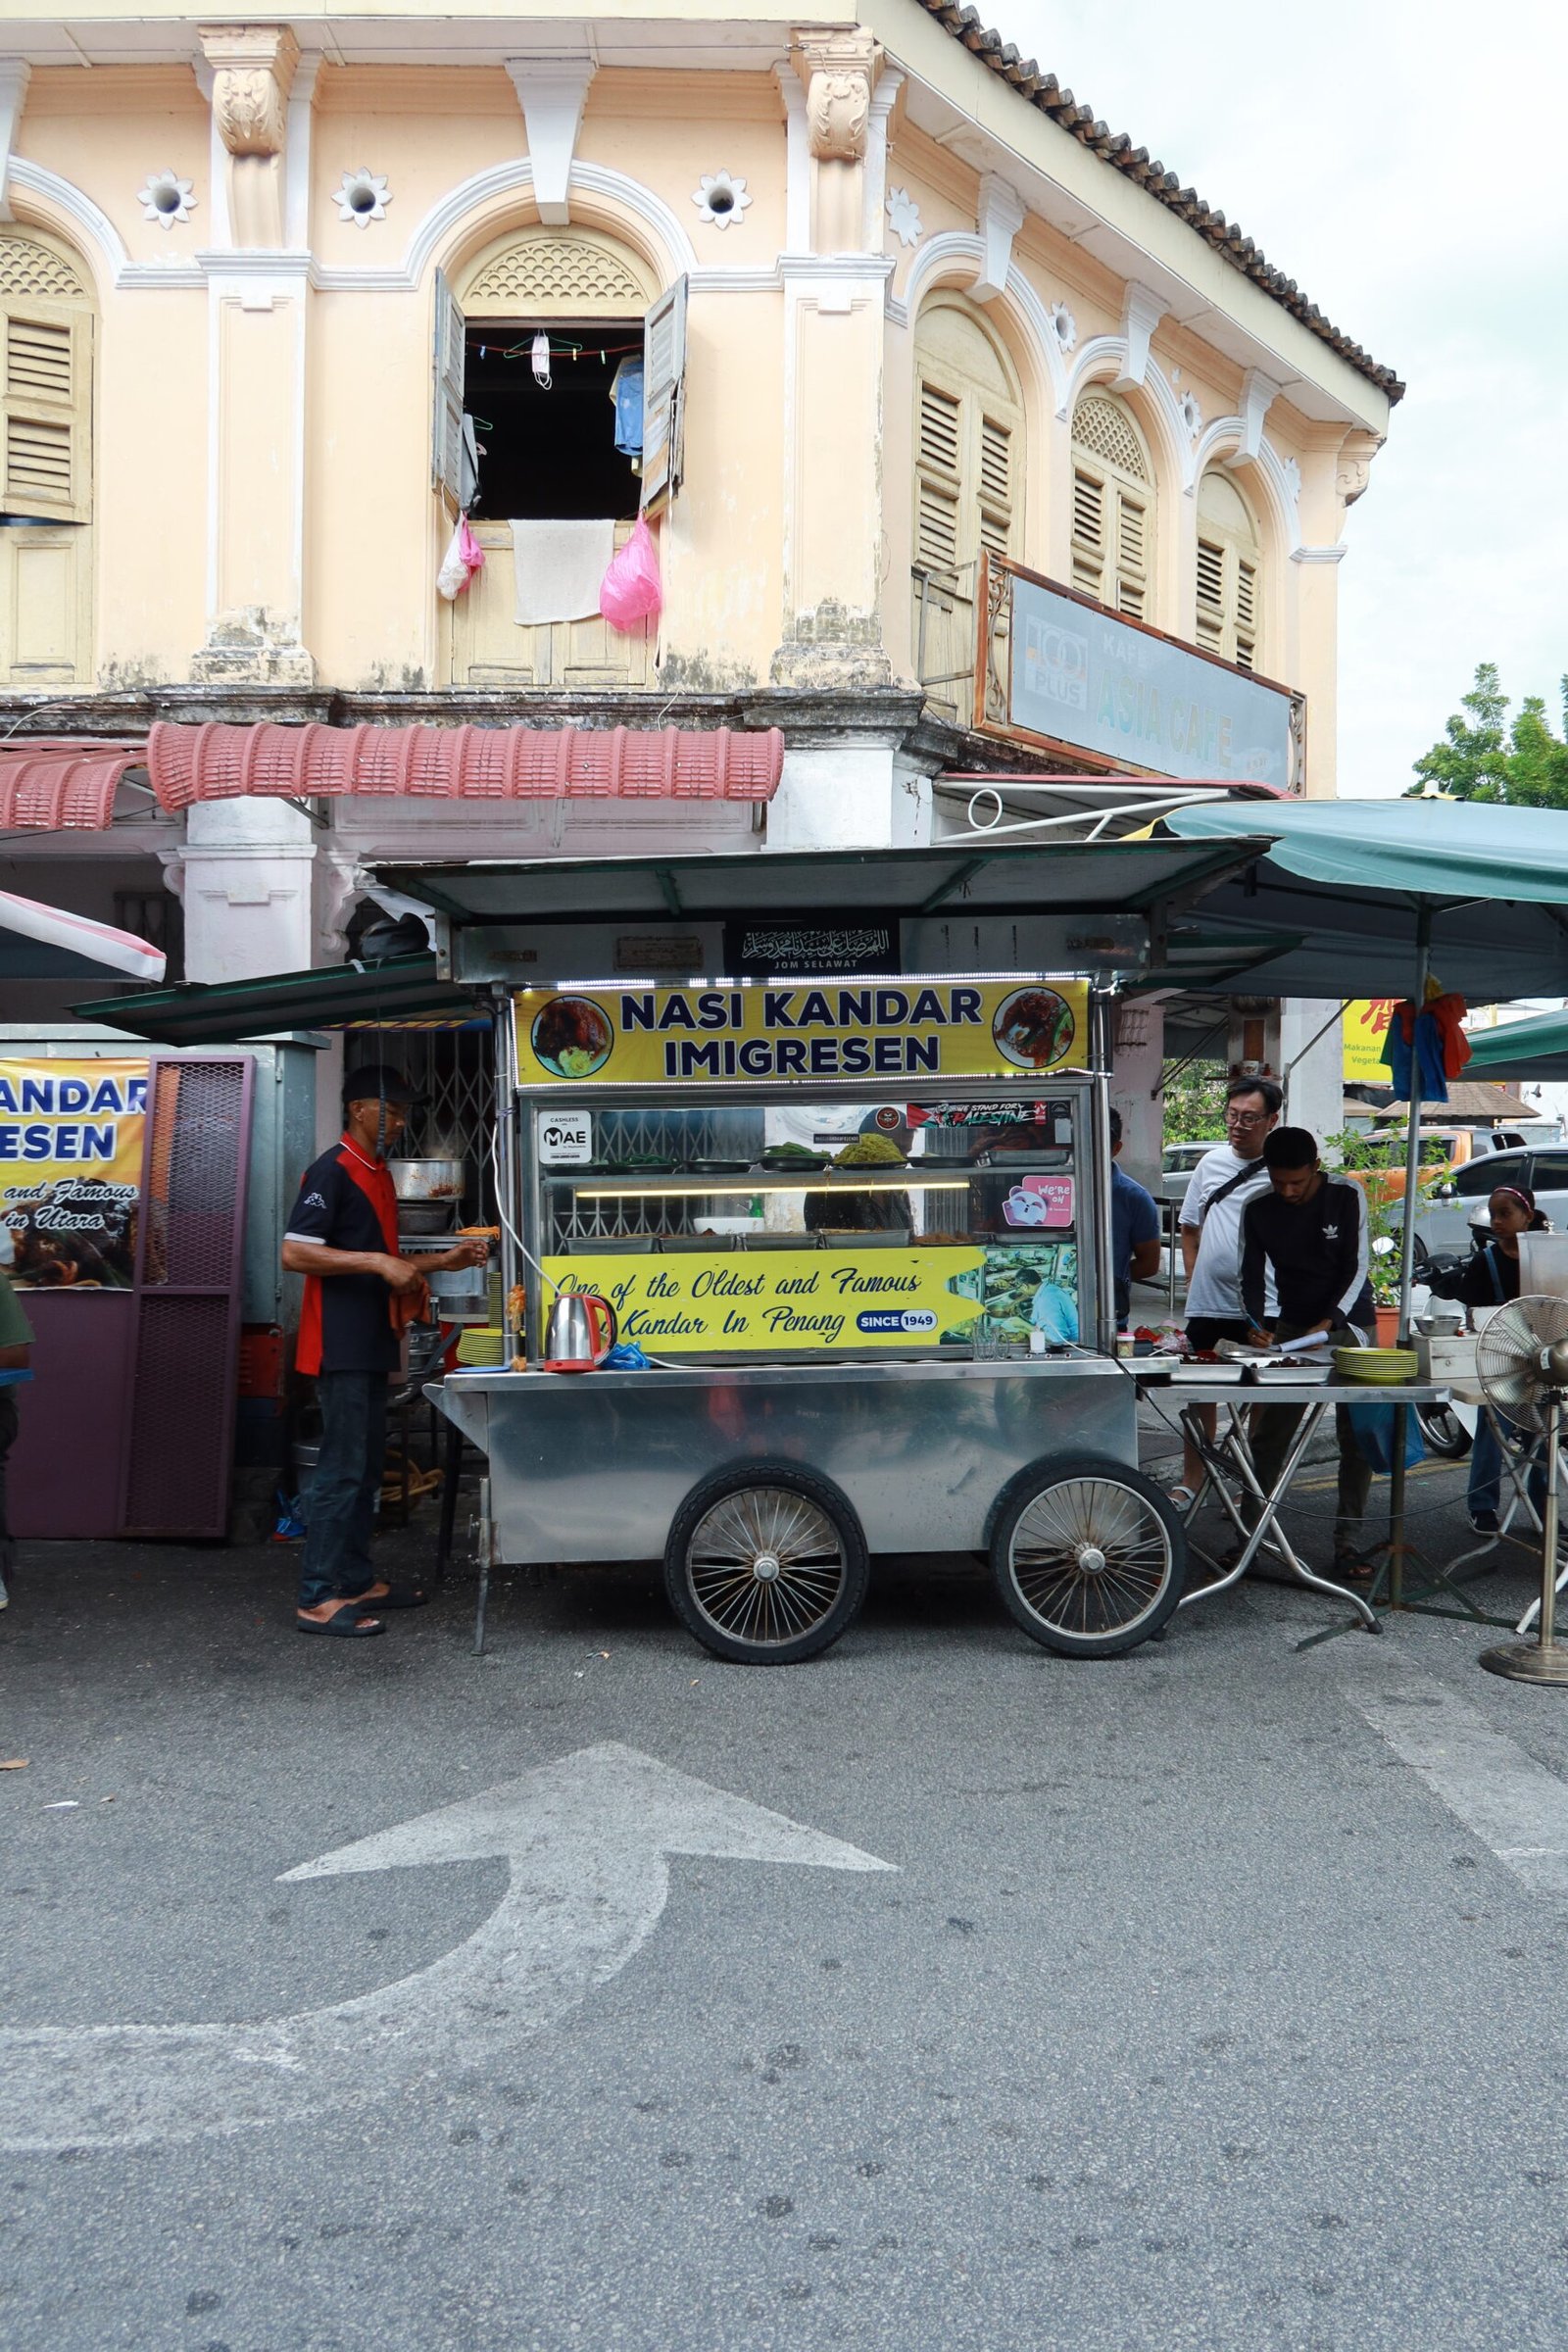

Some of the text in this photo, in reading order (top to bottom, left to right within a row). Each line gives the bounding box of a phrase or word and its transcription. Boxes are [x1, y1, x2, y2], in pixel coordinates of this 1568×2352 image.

[1035, 671, 1082, 705] PLUS
[1097, 668, 1233, 768] ASIA CAFE
[774, 959, 858, 970] JOM SELAWAT
[620, 987, 984, 1032] NASI KANDAR
[663, 1035, 940, 1078] IMIGRESEN
[1344, 1043, 1382, 1053] Makanan
[953, 1108, 1035, 1126] PALESTINE
[0, 1123, 116, 1160] ESEN
[543, 1126, 586, 1147] MAE
[3, 1177, 138, 1204] and Famous
[4, 1205, 106, 1230] in Utara
[611, 1274, 637, 1311] of
[647, 1272, 681, 1298] the
[691, 1268, 767, 1298] Oldest
[775, 1270, 820, 1296] and
[830, 1266, 923, 1295] Famous
[621, 1305, 846, 1344] Kandar In Penang
[860, 1314, 934, 1327] SINCE 1949
